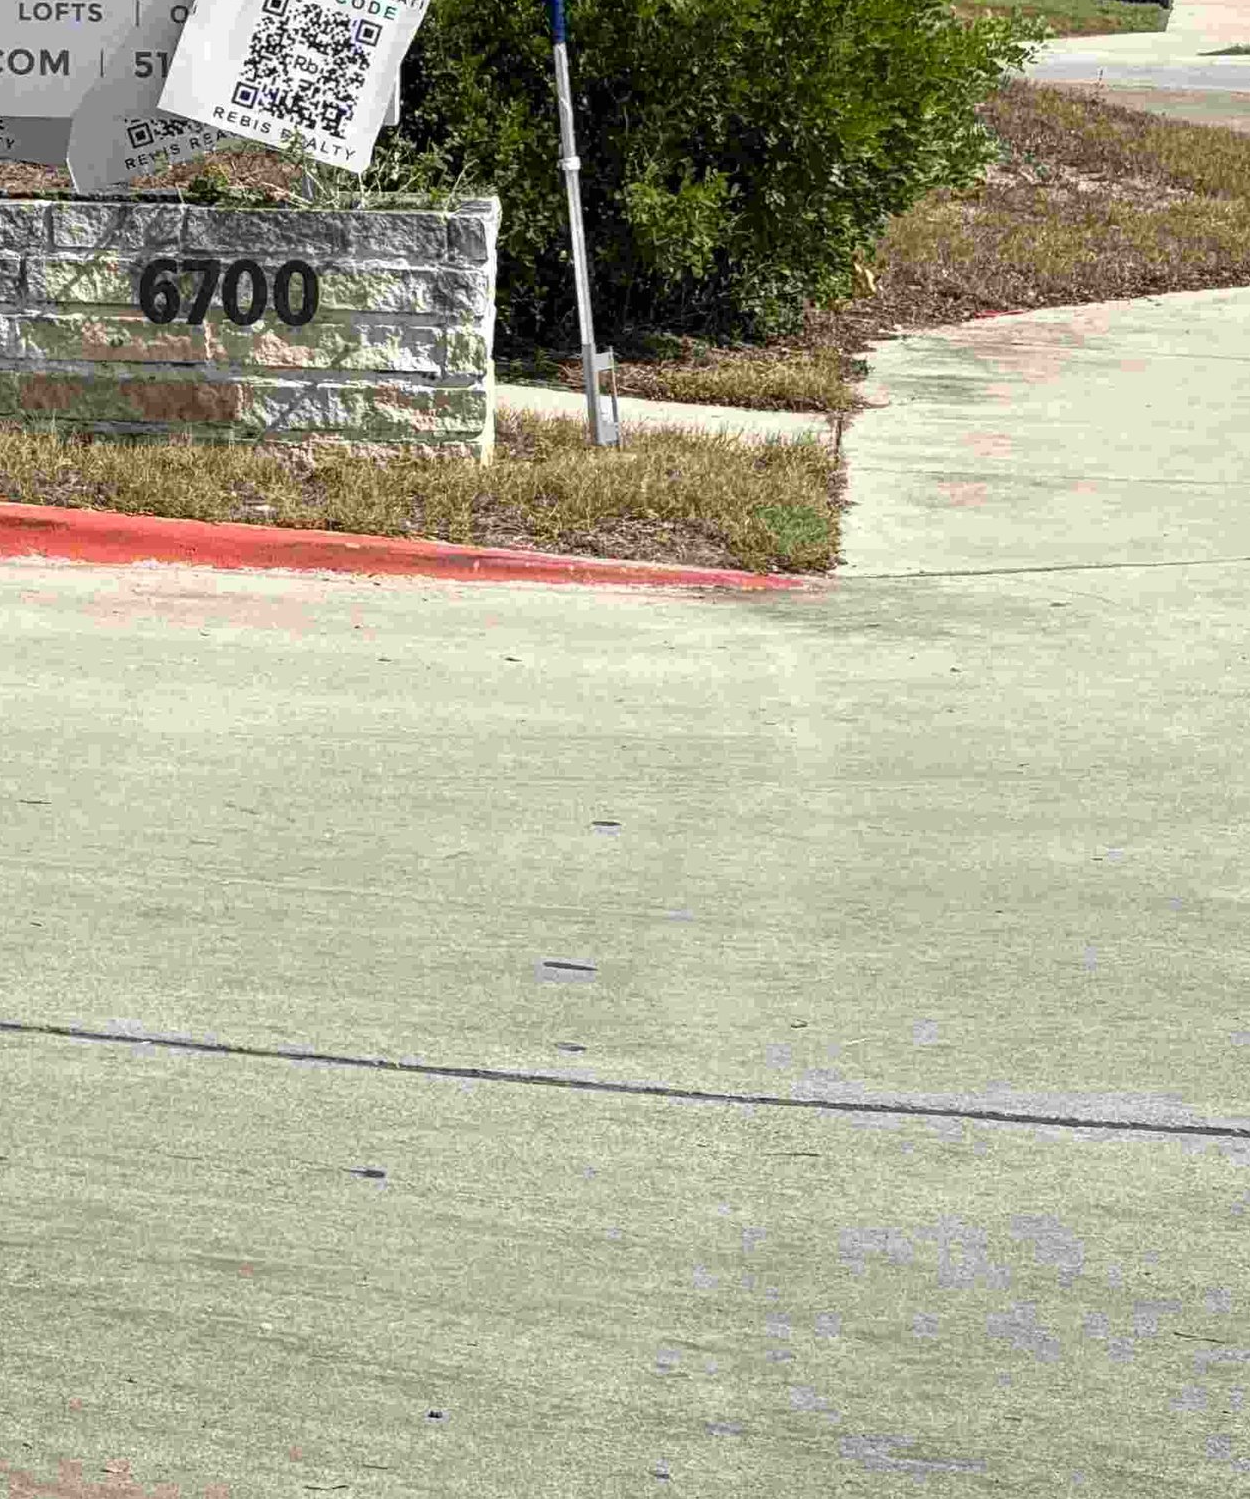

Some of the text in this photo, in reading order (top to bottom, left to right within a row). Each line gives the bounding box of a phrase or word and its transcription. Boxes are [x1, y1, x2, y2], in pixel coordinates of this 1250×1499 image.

[18, 2, 104, 22] LOFTS
[213, 106, 357, 162] REBIS RALTY
[139, 258, 320, 327] 6700
